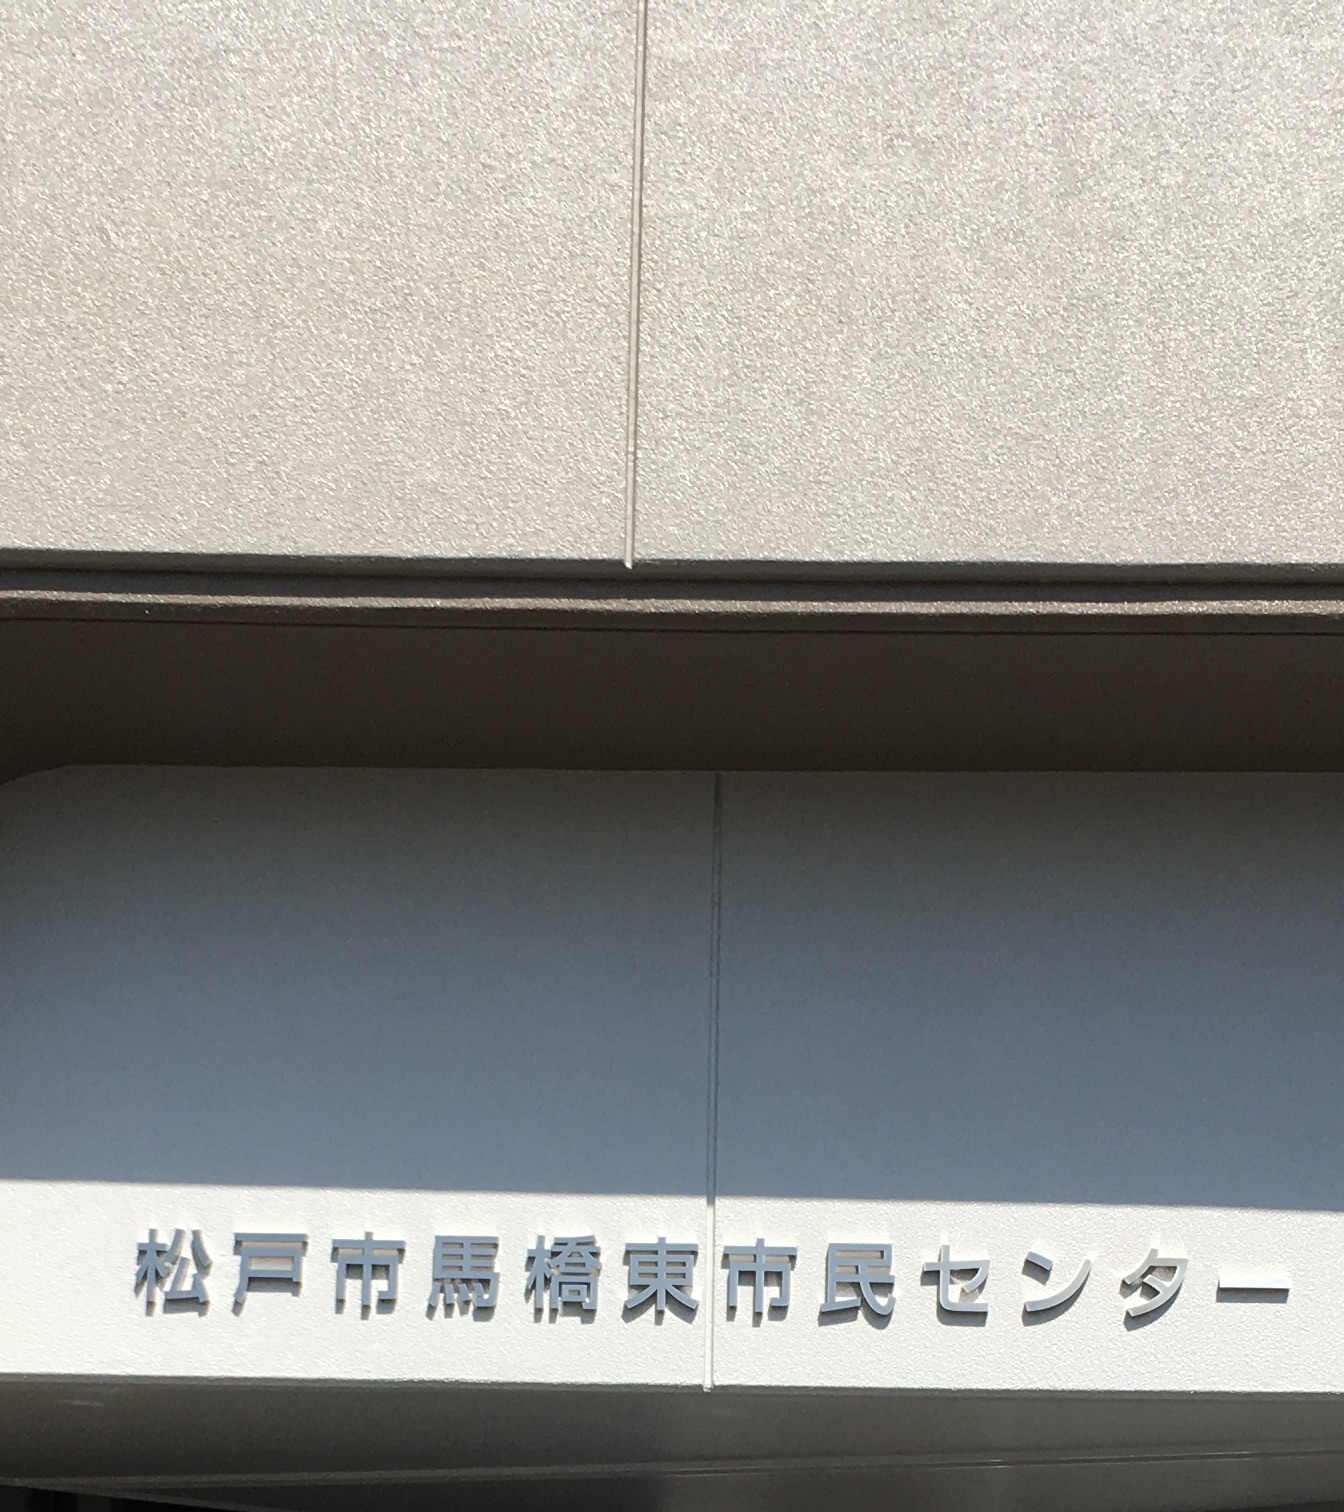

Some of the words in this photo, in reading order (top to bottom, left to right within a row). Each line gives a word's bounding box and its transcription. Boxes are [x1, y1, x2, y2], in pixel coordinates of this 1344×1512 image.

[135, 1227, 1290, 1328] 松戸市馬橋東市民センター
